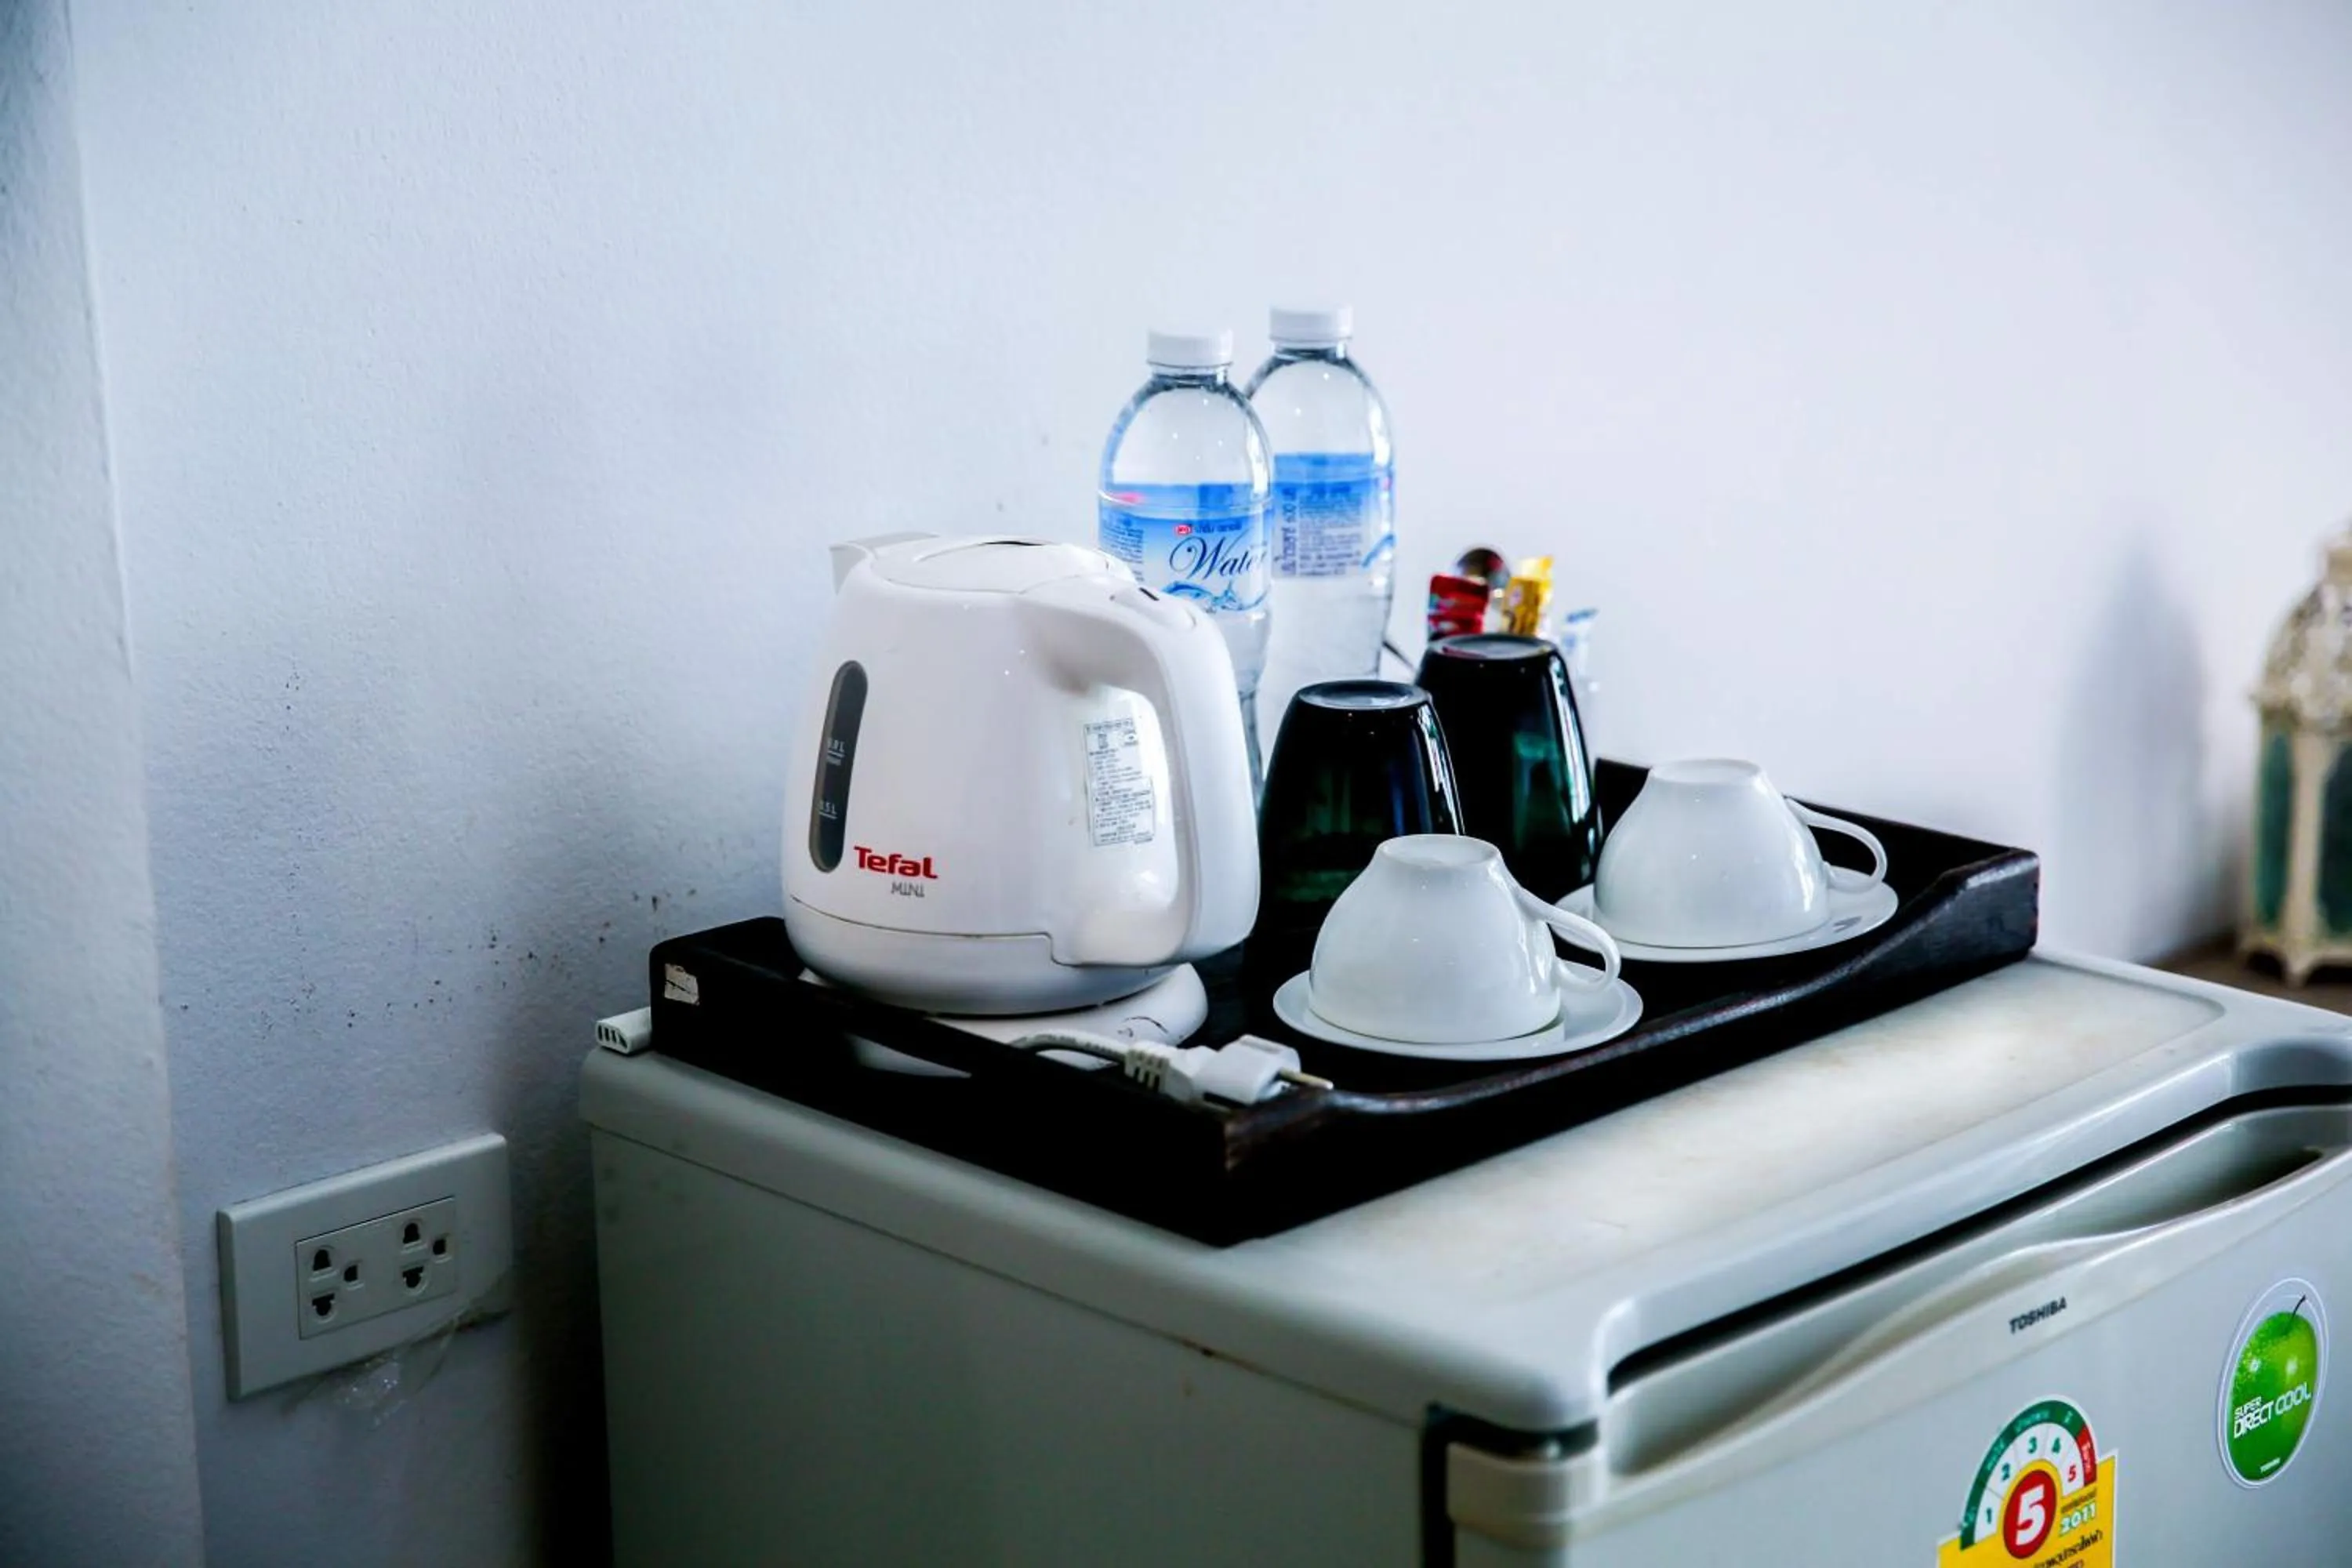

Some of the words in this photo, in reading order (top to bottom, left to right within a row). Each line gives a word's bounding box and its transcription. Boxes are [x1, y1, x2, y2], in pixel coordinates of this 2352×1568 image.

[853, 844, 938, 880] Tefal
[891, 880, 925, 898] MINI
[2009, 1296, 2067, 1334] TOSHIBA
[2234, 1399, 2274, 1439] DIRECT
[2275, 1381, 2312, 1415] COOL
[2027, 1436, 2038, 1454] 3
[2052, 1437, 2062, 1454] 4
[2067, 1465, 2077, 1483] 5
[1987, 1507, 1993, 1525] 1
[2016, 1483, 2045, 1547] 5
[2060, 1501, 2096, 1537] 2011
